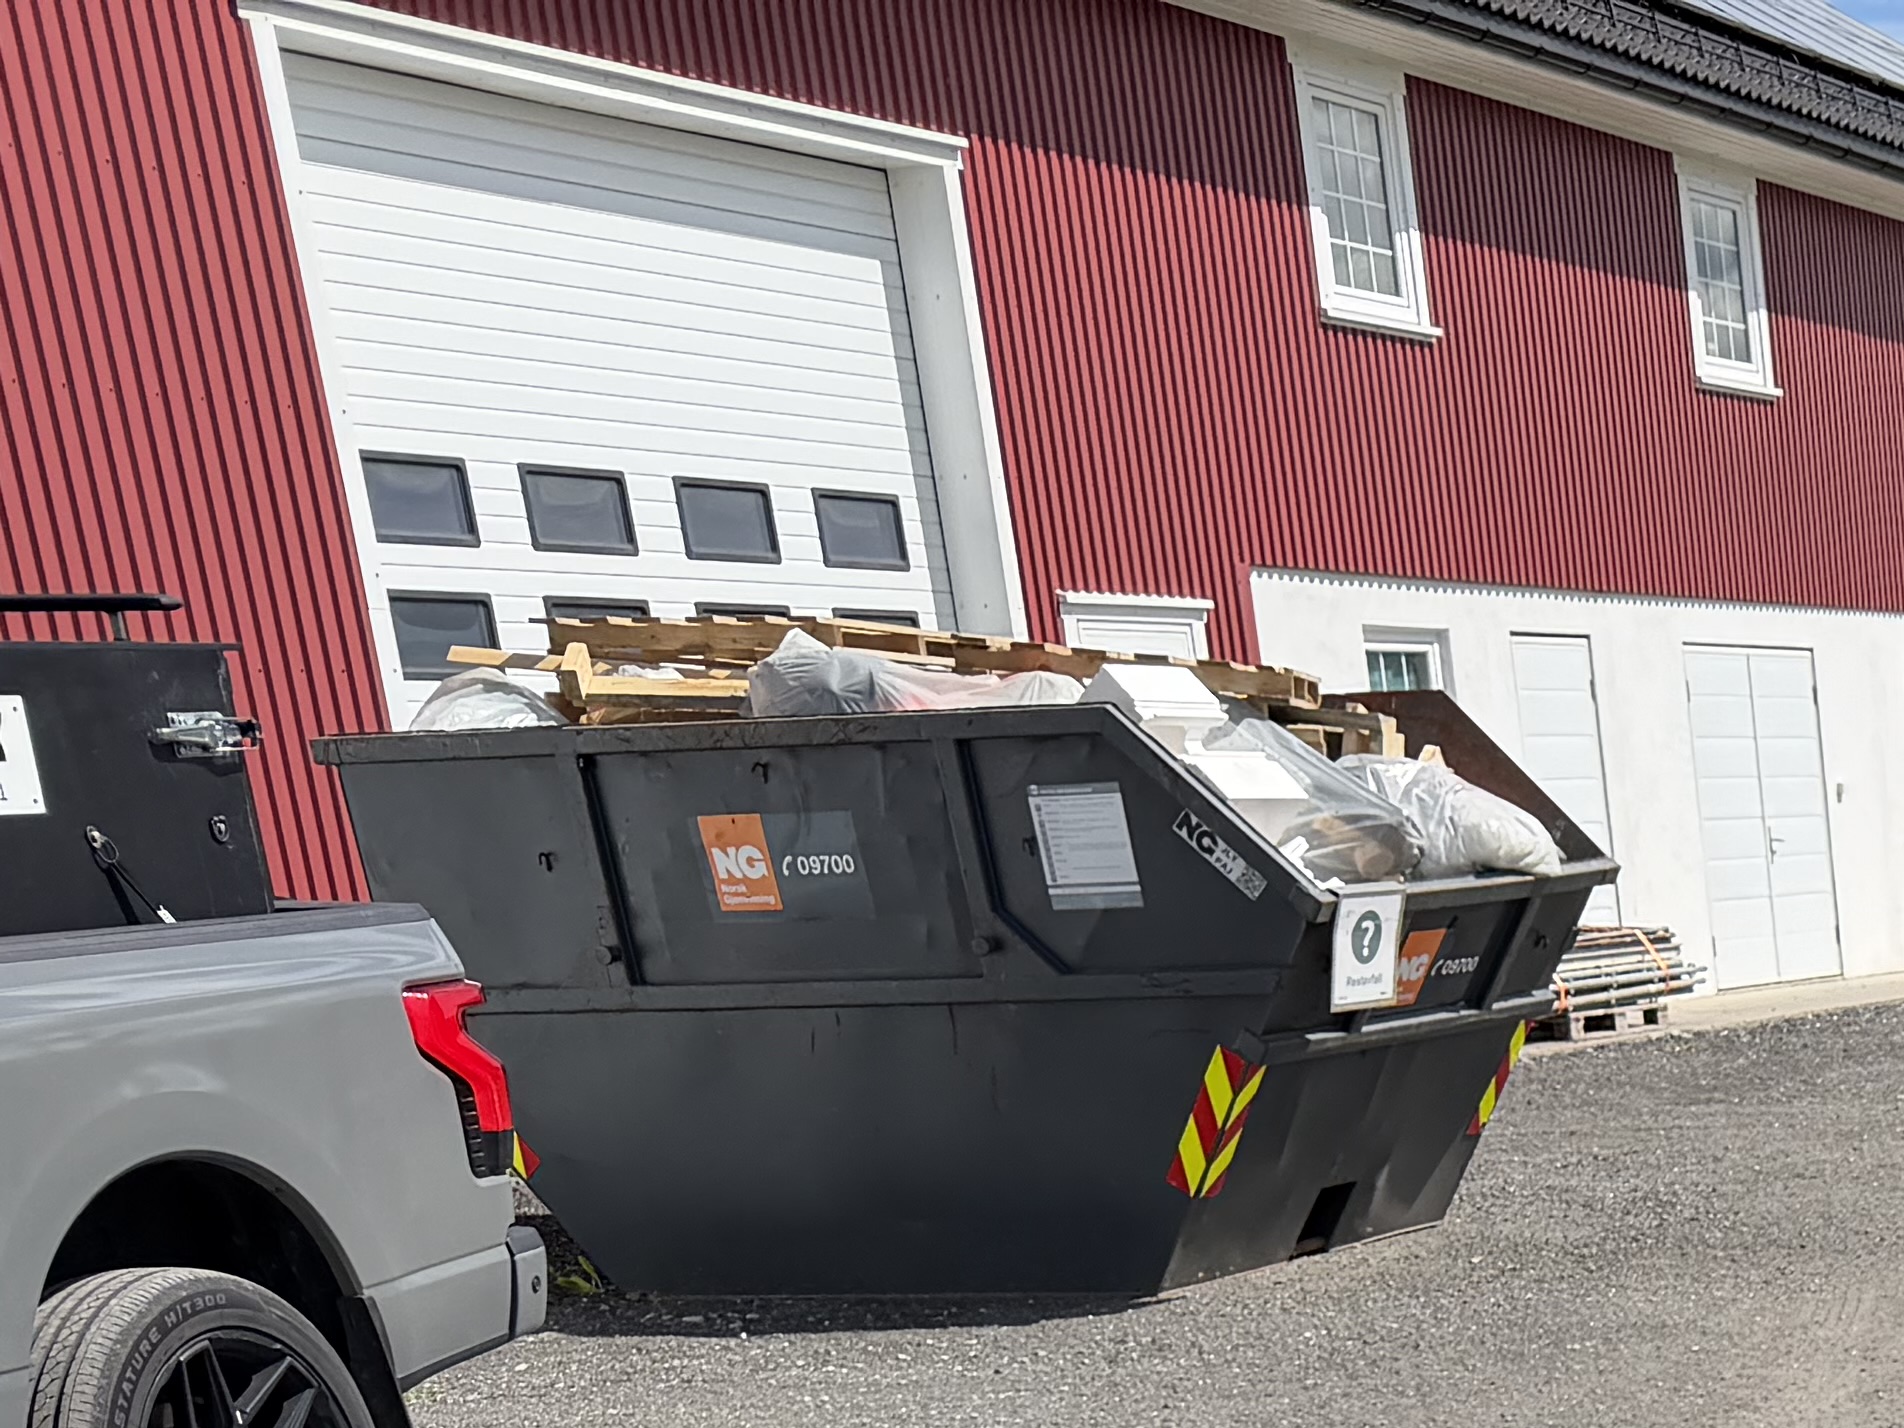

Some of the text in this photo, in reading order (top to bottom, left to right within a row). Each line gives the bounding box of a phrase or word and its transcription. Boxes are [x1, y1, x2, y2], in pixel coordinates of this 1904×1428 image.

[1175, 811, 1219, 858] NG
[711, 845, 768, 880] NG
[796, 854, 855, 876] 09700
[1397, 953, 1430, 982] NG
[1440, 955, 1480, 976] 09700
[113, 1293, 227, 1428] STATURE H/T300
